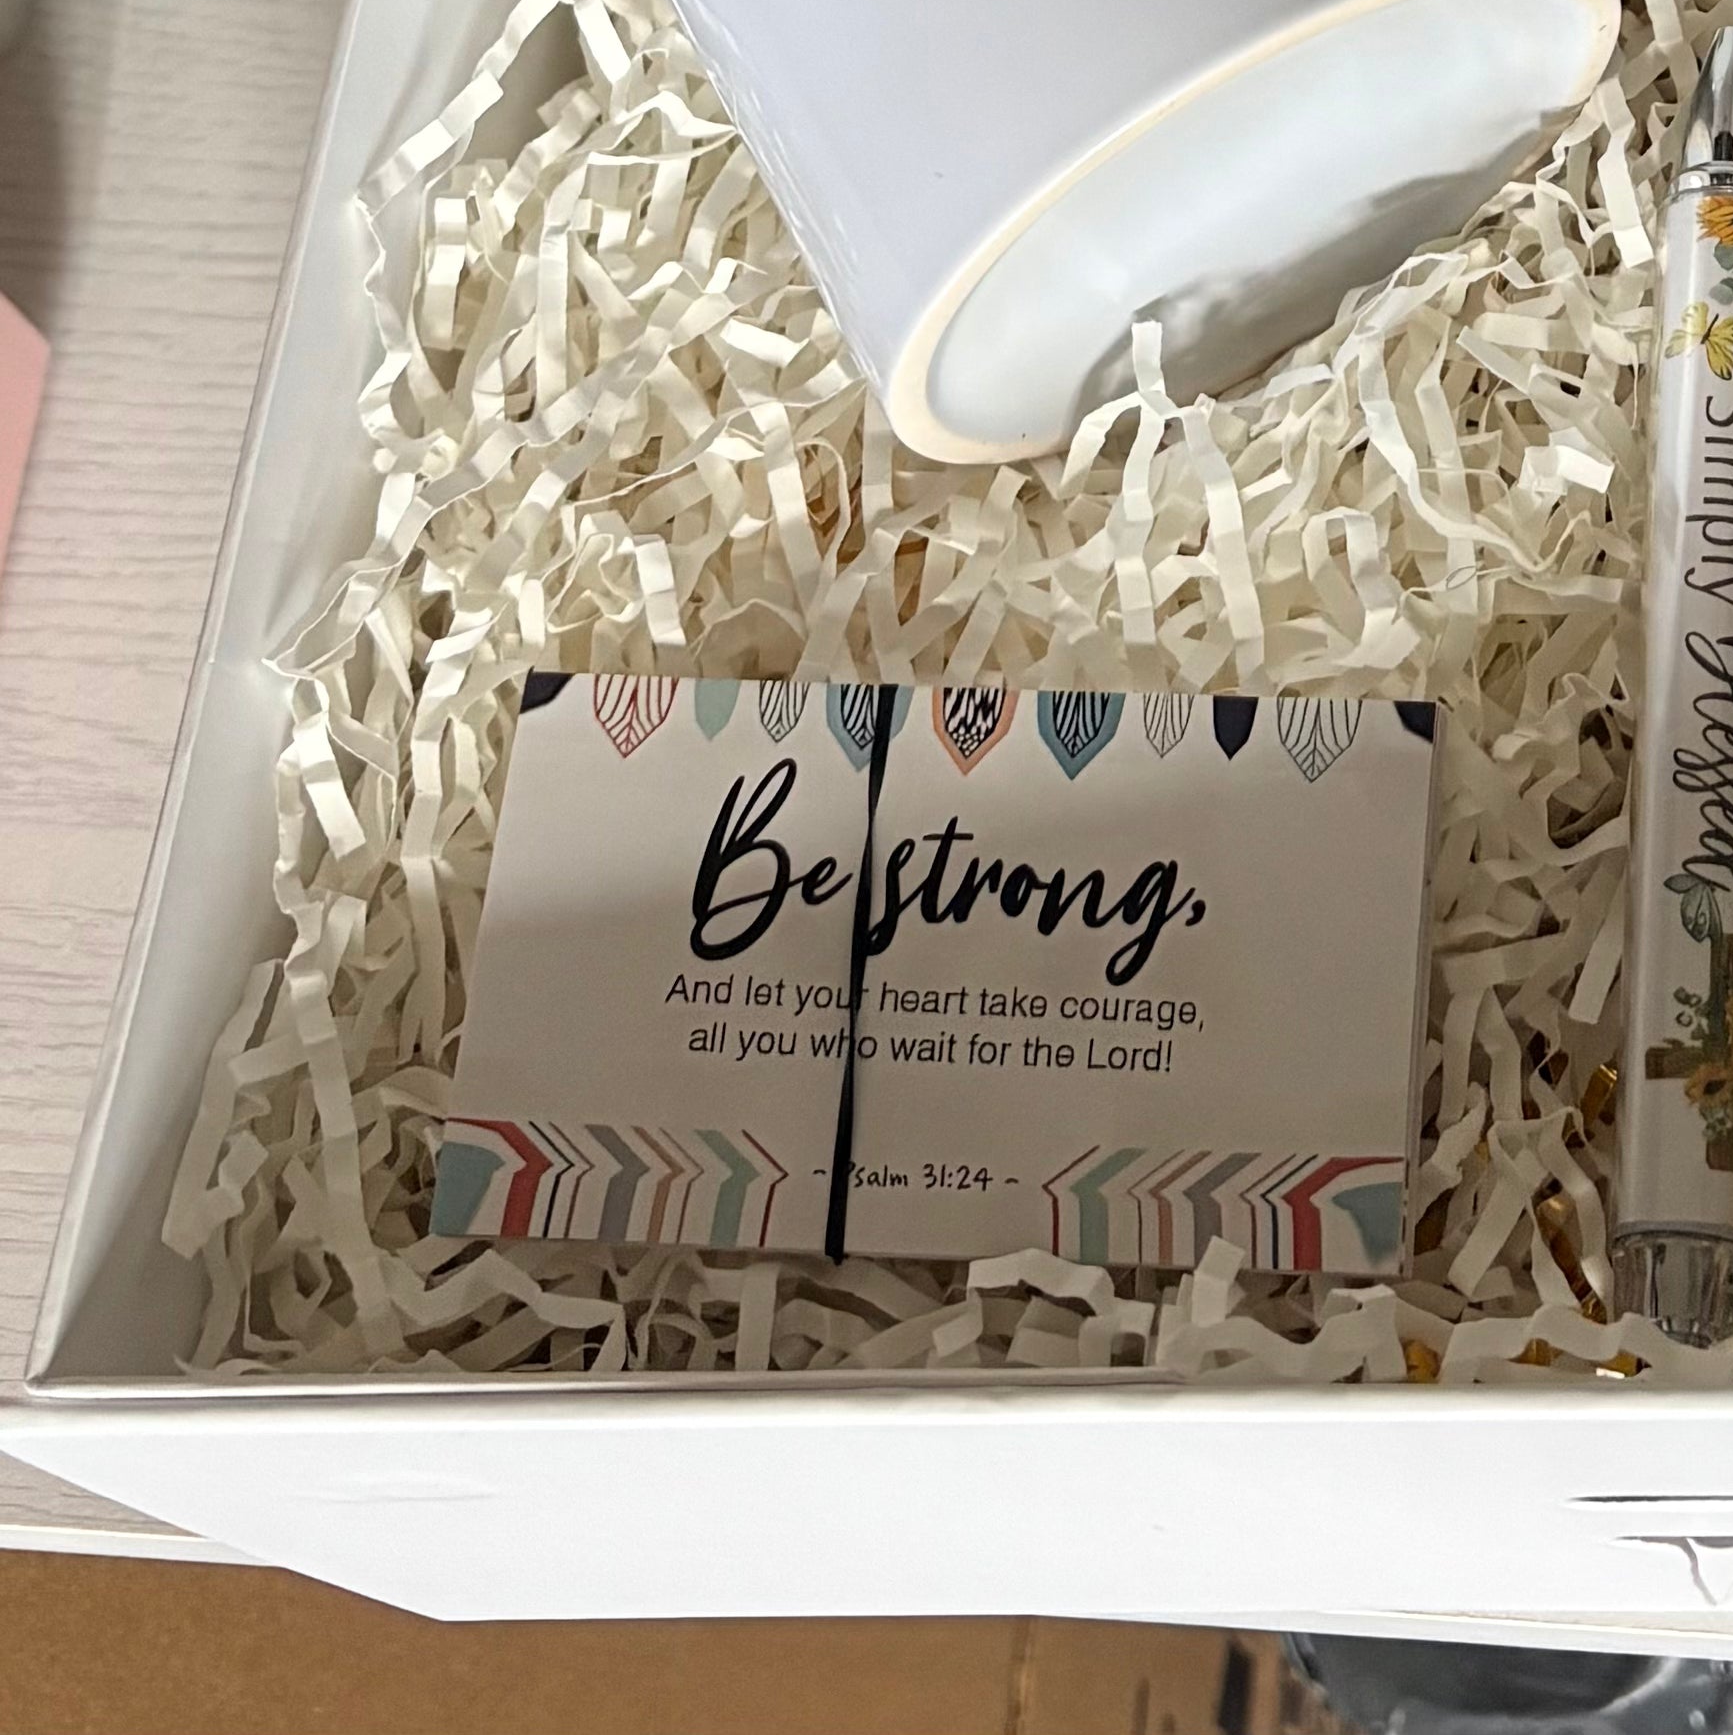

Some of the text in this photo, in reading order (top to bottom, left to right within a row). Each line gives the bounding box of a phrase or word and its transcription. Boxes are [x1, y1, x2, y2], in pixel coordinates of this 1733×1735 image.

[689, 757, 1207, 986] Be strong,
[665, 973, 735, 1004] And
[744, 975, 786, 1007] let
[878, 981, 970, 1015] heart
[979, 986, 1048, 1018] take
[1059, 996, 1205, 1033] courage,
[688, 1021, 1174, 1073] all you who wait for the Lord!
[923, 1162, 994, 1192] 31:24
